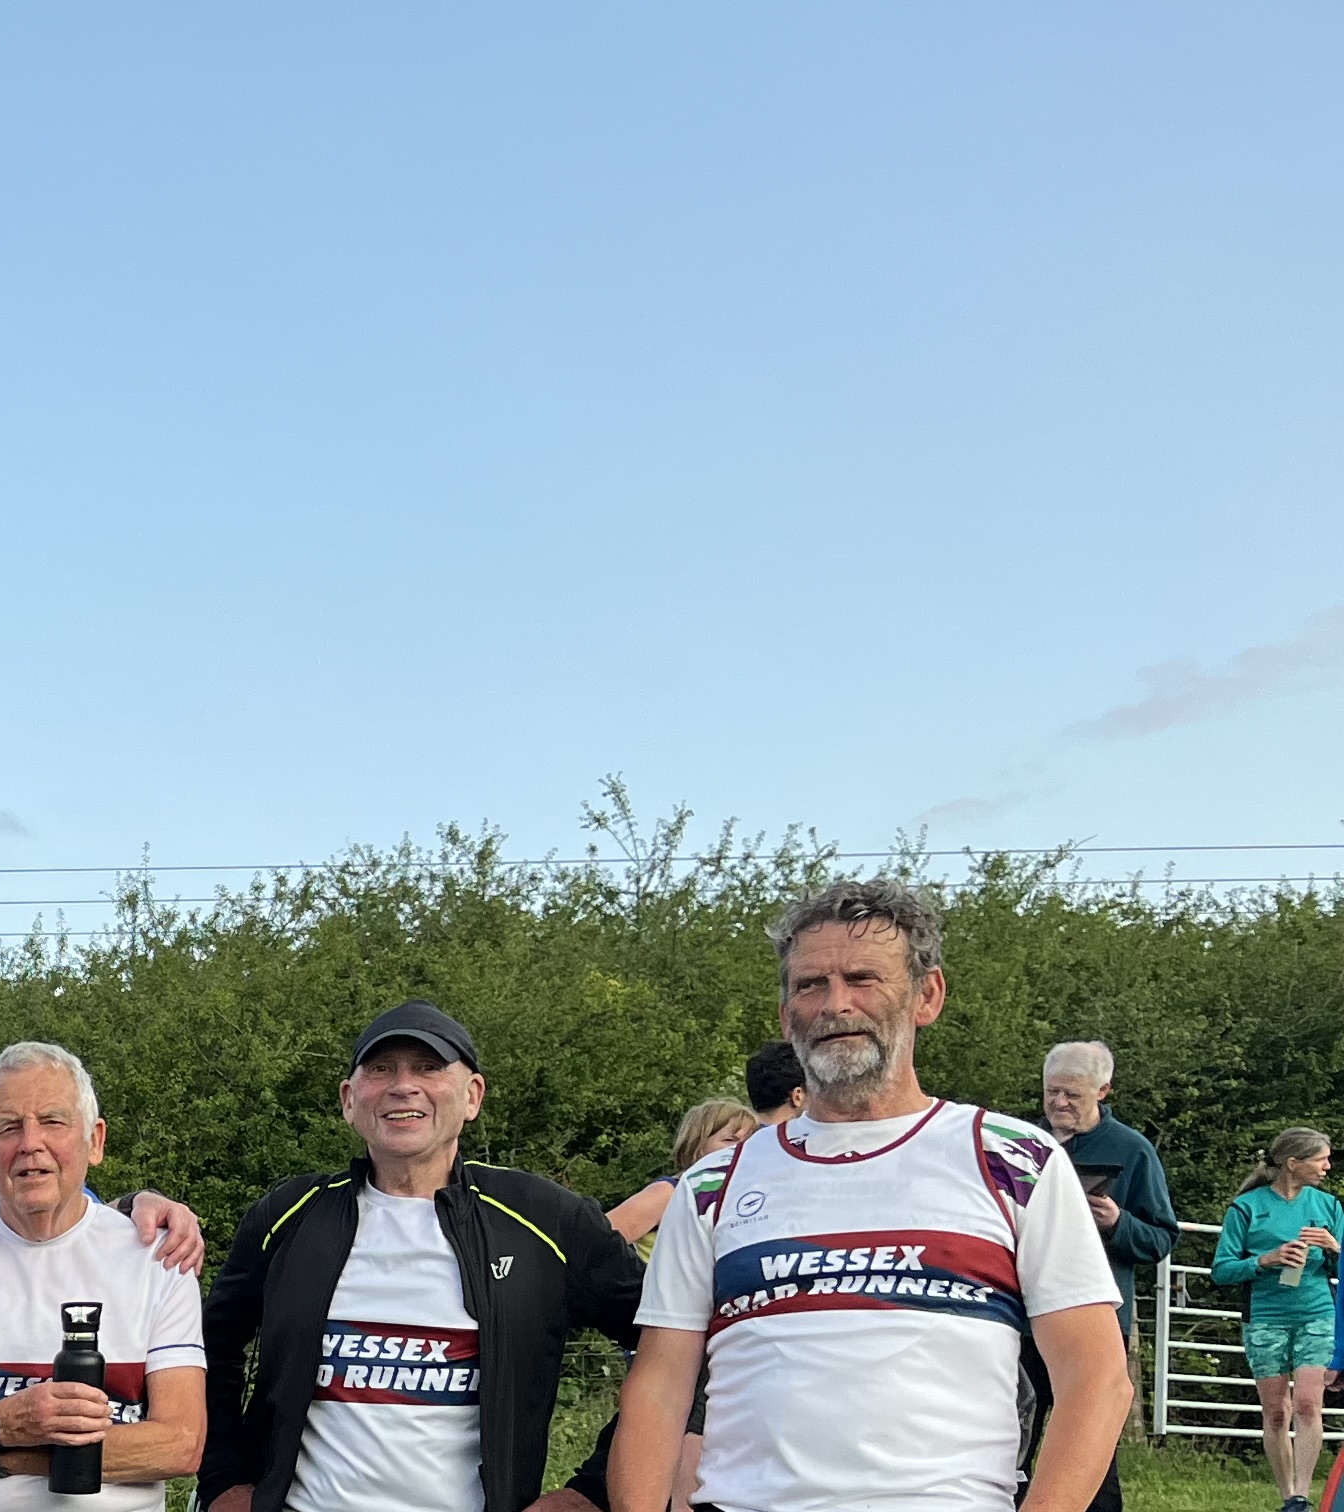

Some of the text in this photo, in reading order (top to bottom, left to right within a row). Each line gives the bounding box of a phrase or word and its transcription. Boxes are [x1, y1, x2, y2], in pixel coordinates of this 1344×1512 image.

[760, 1245, 926, 1281] WESSEX
[807, 1275, 994, 1303] RUNNERS
[343, 1364, 480, 1392] RUNNE
